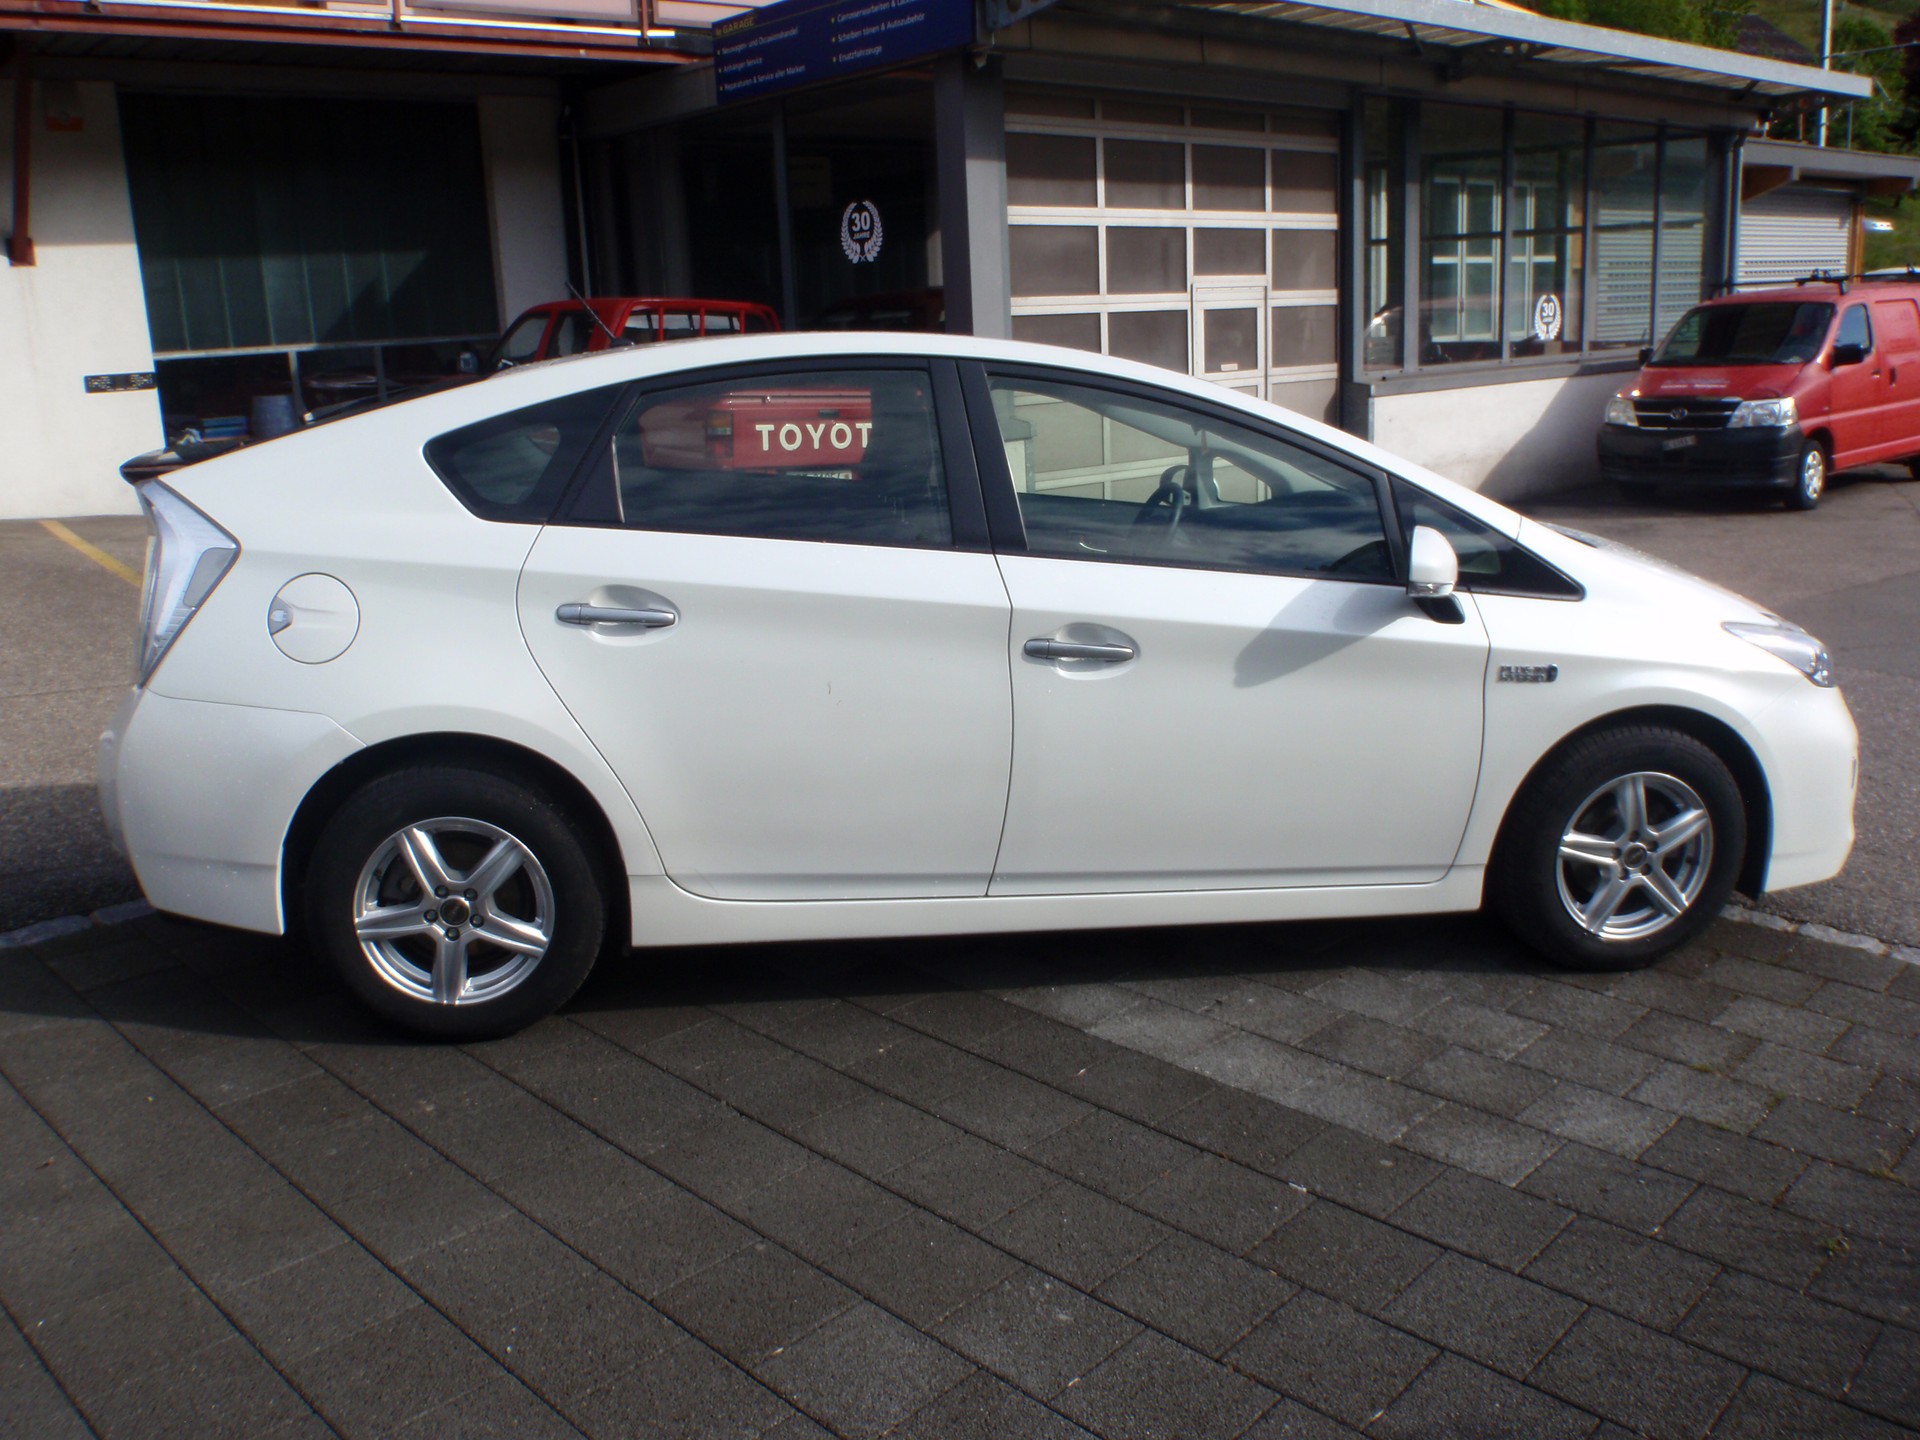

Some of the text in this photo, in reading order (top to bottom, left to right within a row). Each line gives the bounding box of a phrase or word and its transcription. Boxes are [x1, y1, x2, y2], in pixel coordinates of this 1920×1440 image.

[723, 19, 754, 35] GARAGE
[851, 211, 871, 232] 30
[1542, 302, 1555, 317] 30
